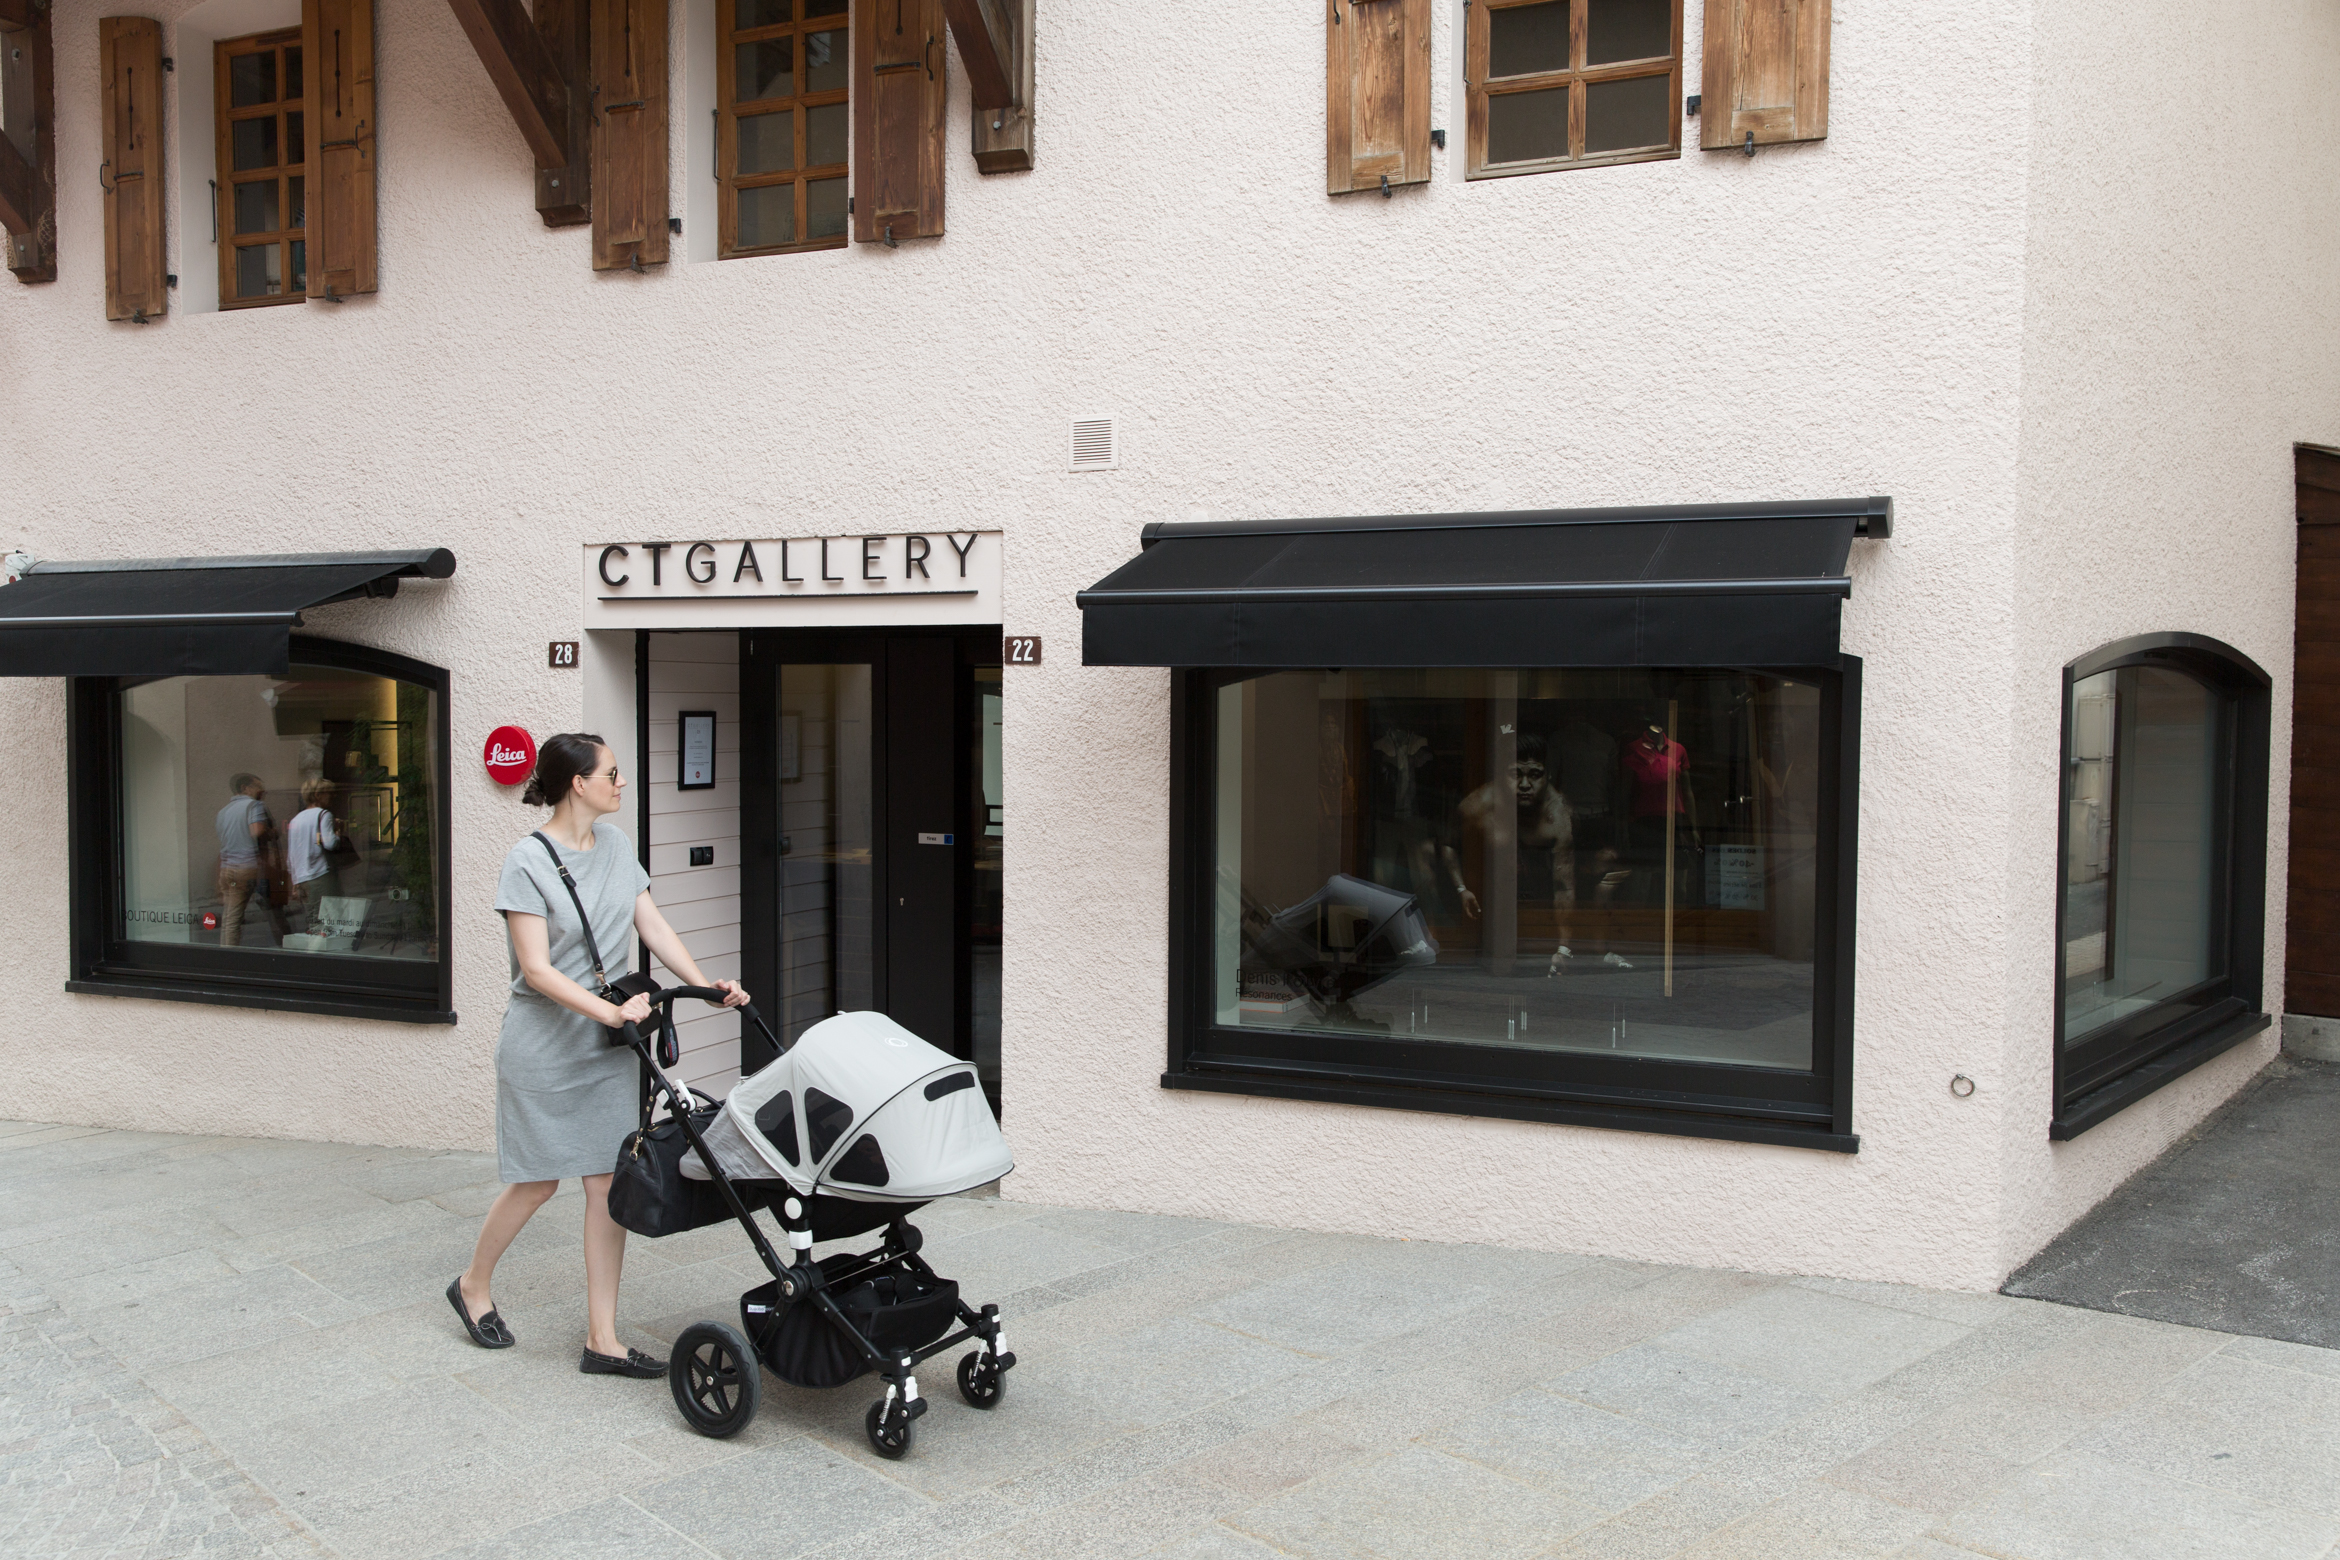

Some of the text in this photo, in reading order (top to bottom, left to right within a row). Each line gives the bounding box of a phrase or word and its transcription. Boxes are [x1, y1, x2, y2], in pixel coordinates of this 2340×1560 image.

[598, 533, 979, 587] CTGALLERY
[555, 644, 573, 665] 28
[1012, 638, 1034, 663] 22
[486, 743, 527, 767] Leica
[173, 913, 199, 924] LEICA
[327, 918, 335, 926] du
[336, 919, 354, 927] mardi
[1236, 968, 1277, 985] Denis
